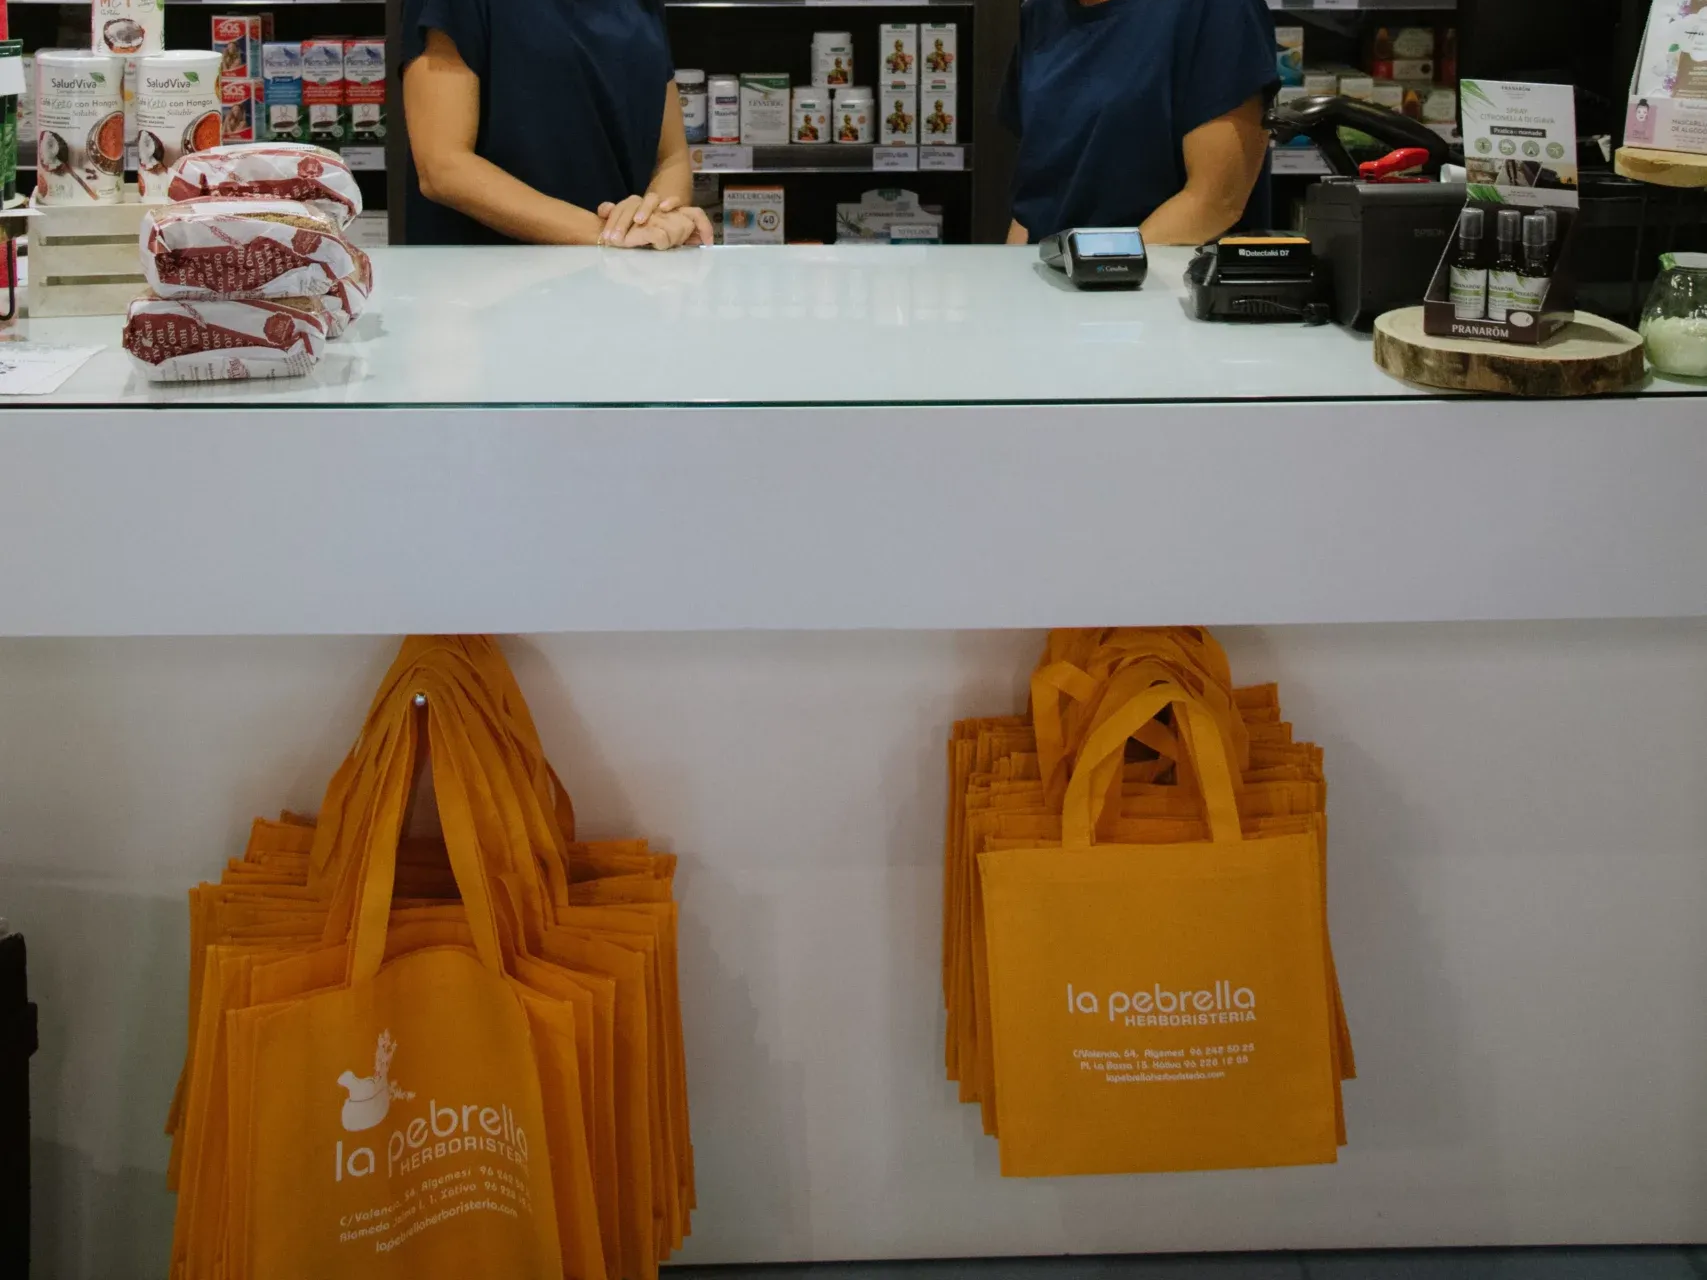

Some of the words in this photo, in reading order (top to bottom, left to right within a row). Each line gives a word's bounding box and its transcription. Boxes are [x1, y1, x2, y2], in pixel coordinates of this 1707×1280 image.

[51, 78, 97, 89] SaludViva
[146, 78, 191, 88] SaludViva
[92, 100, 118, 109] Hongos
[186, 99, 213, 108] Hongos
[1067, 983, 1099, 1014] la
[1108, 980, 1256, 1022] pebrella
[1125, 1011, 1257, 1027] HERBORISTERIA
[335, 1140, 375, 1182] la
[388, 1098, 529, 1179] pebrella
